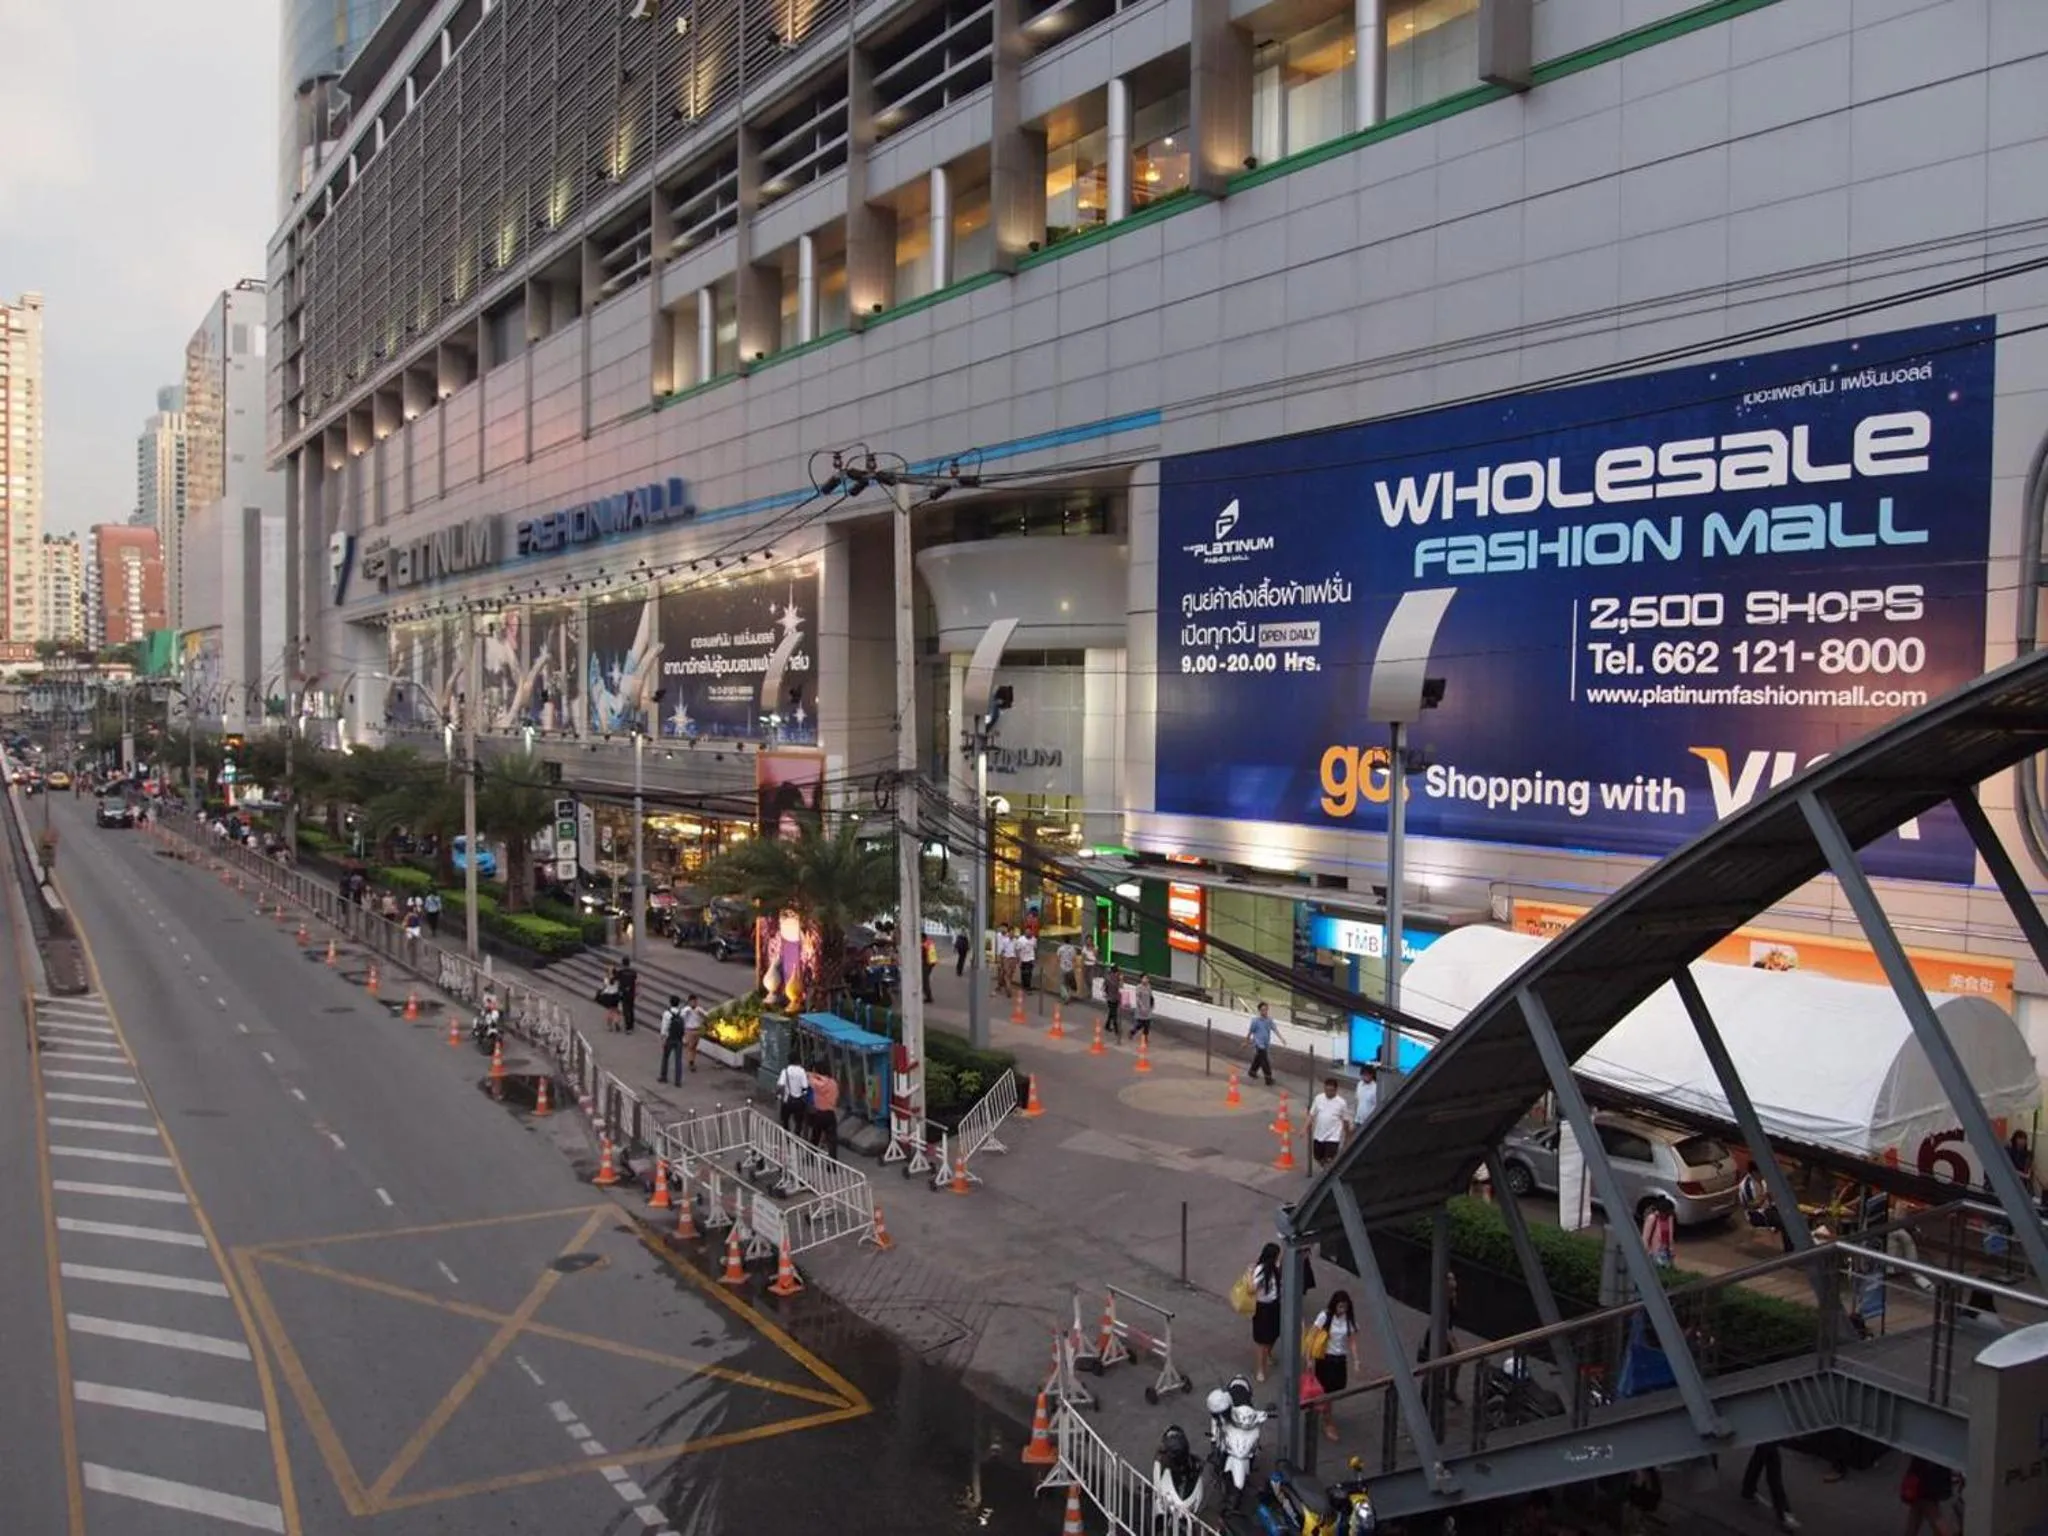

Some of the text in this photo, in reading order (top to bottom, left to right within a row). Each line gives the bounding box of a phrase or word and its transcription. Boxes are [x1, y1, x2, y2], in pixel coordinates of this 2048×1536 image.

[605, 477, 698, 534] MALL
[1589, 584, 1925, 634] 2,500 SHOPS
[1181, 620, 1256, 651] เปิดทุกวัน
[1260, 626, 1318, 642] OPEN DAILY
[1182, 652, 1322, 673] 9.00-20.00 Hrs.
[1587, 637, 1926, 676] Tel. 662 121-8000
[1587, 685, 1928, 708] www.platinumfashionmall.com
[1426, 764, 1589, 817] Shopping
[1599, 774, 1686, 815] with
[1346, 929, 1379, 953] TMB
